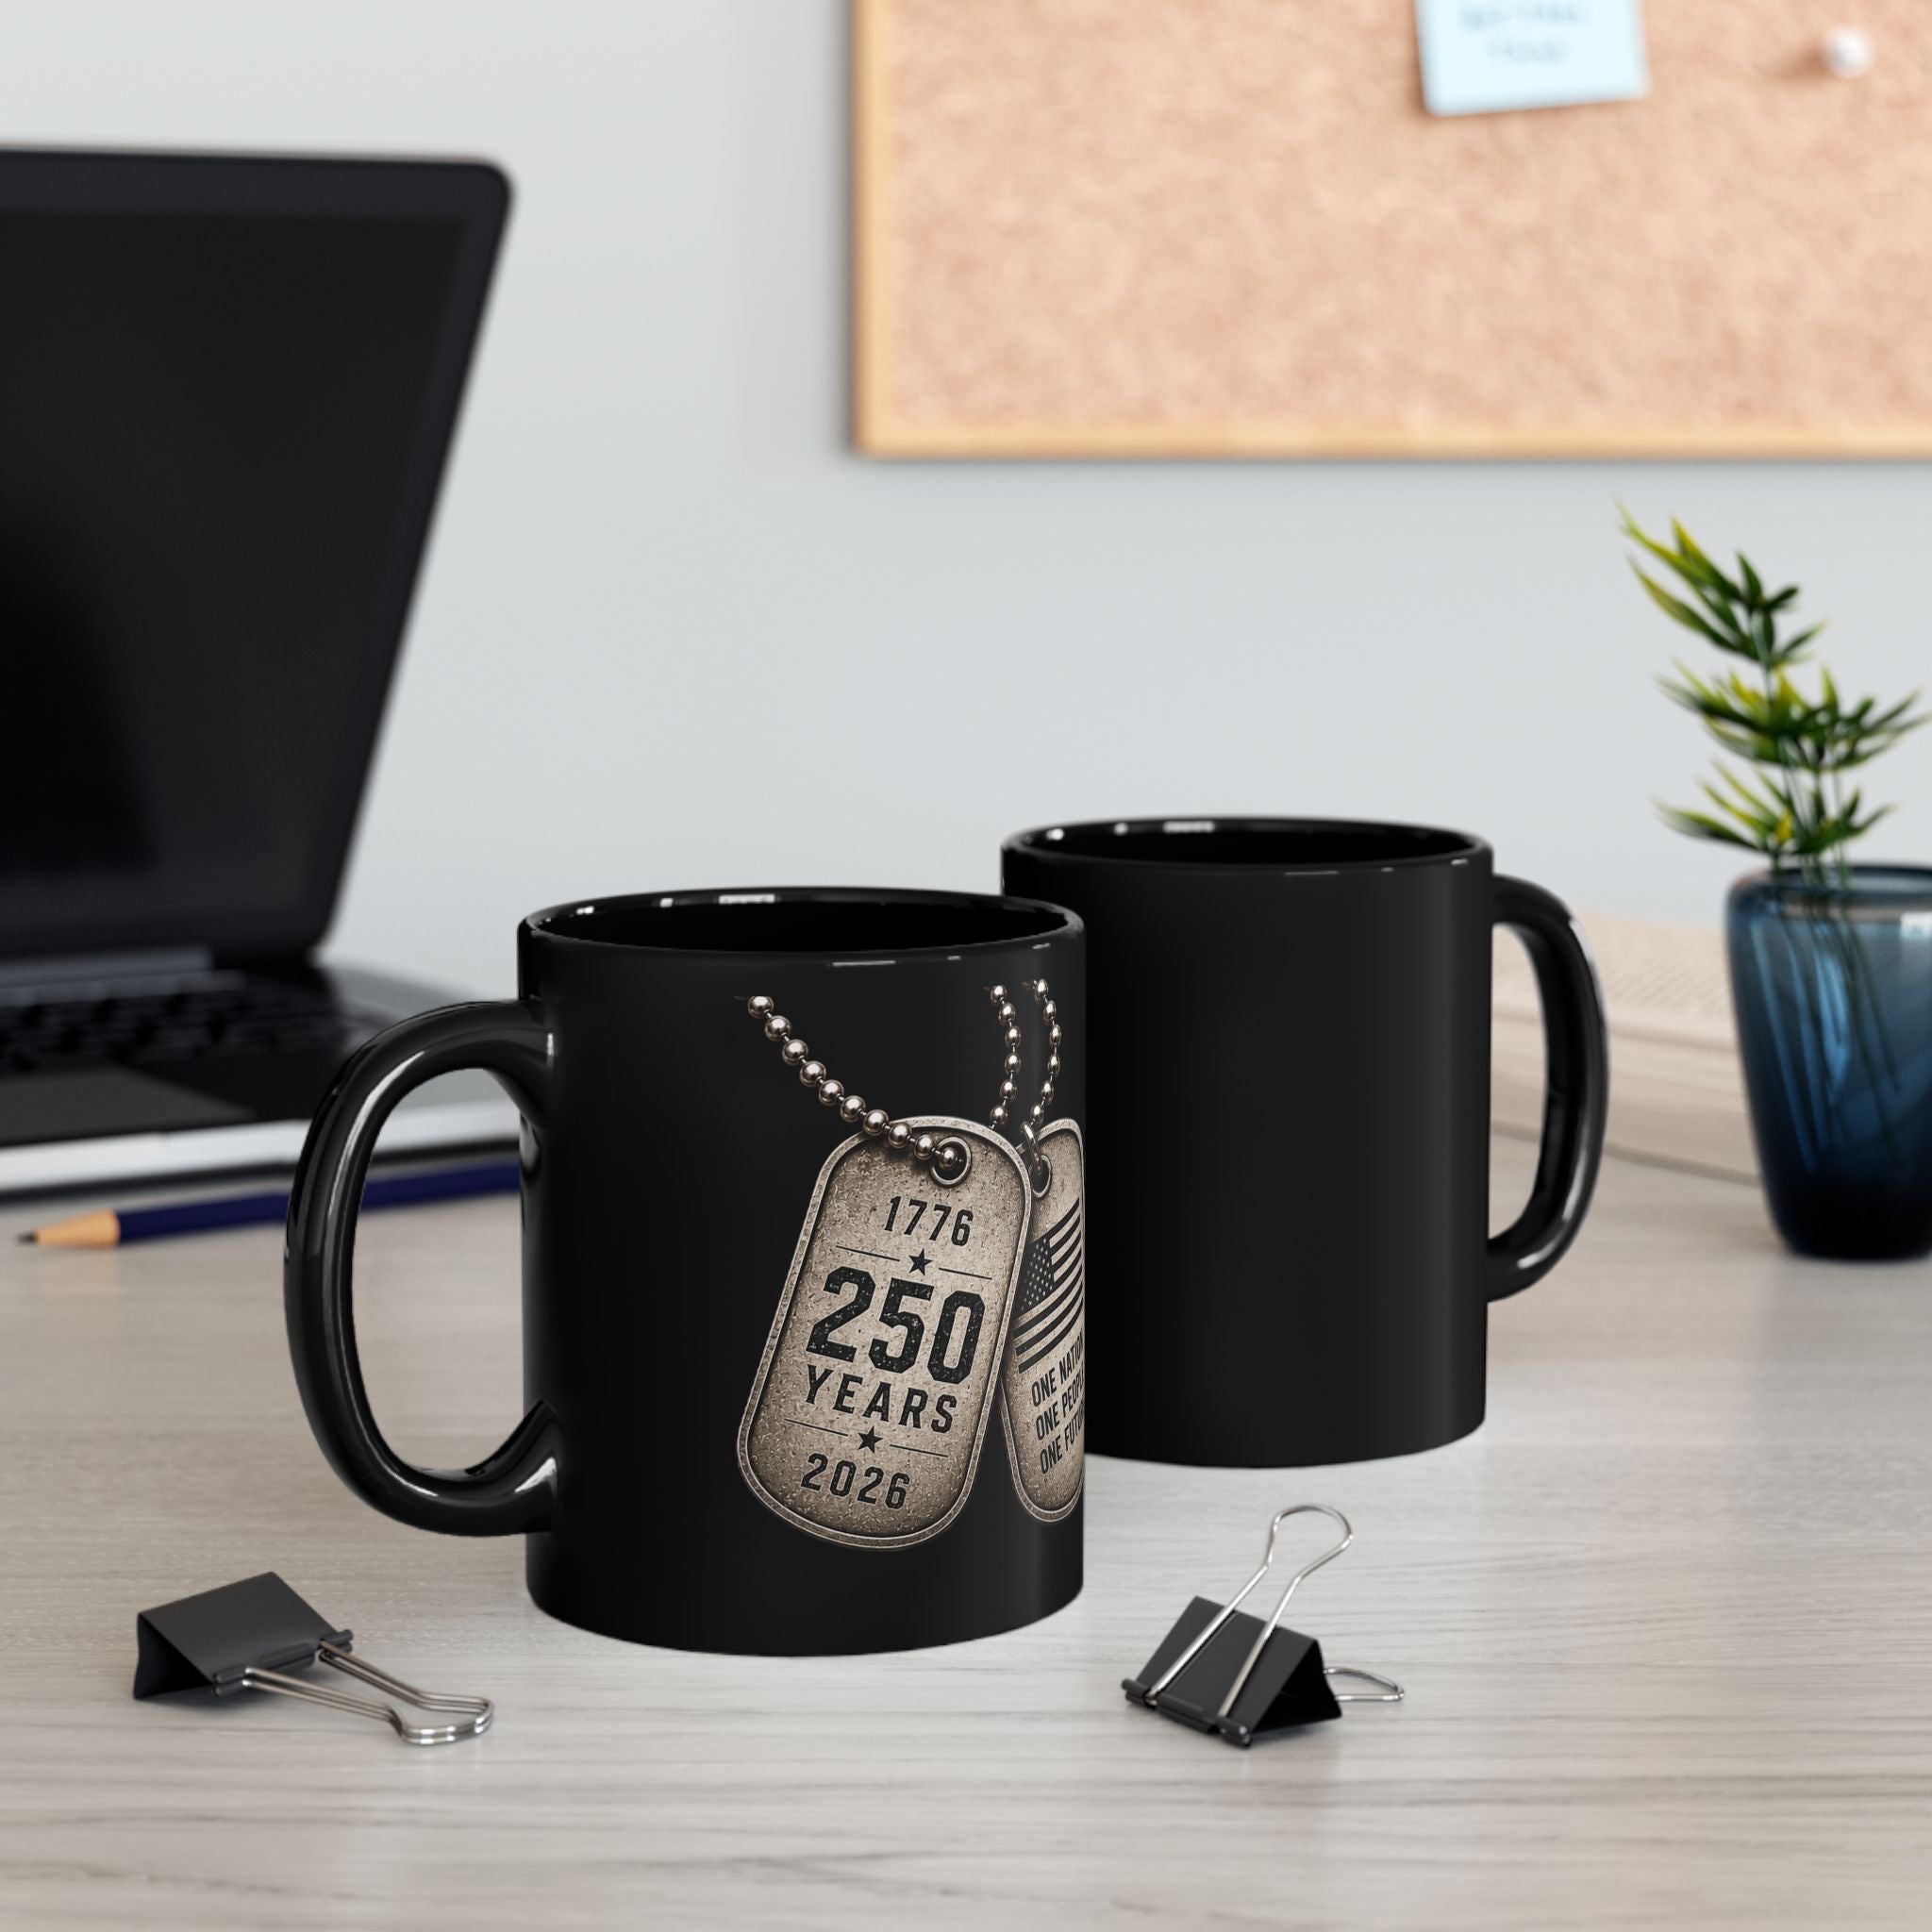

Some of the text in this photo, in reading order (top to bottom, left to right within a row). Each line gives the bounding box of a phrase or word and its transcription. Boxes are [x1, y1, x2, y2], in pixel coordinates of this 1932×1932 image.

[884, 1196, 974, 1247] 1776
[806, 1266, 986, 1385] 250
[805, 1364, 958, 1434] YEARS
[1031, 1368, 1058, 1407] ONE
[1036, 1401, 1060, 1441] ONE
[1040, 1435, 1062, 1474] ONE
[800, 1453, 910, 1509] 2026
